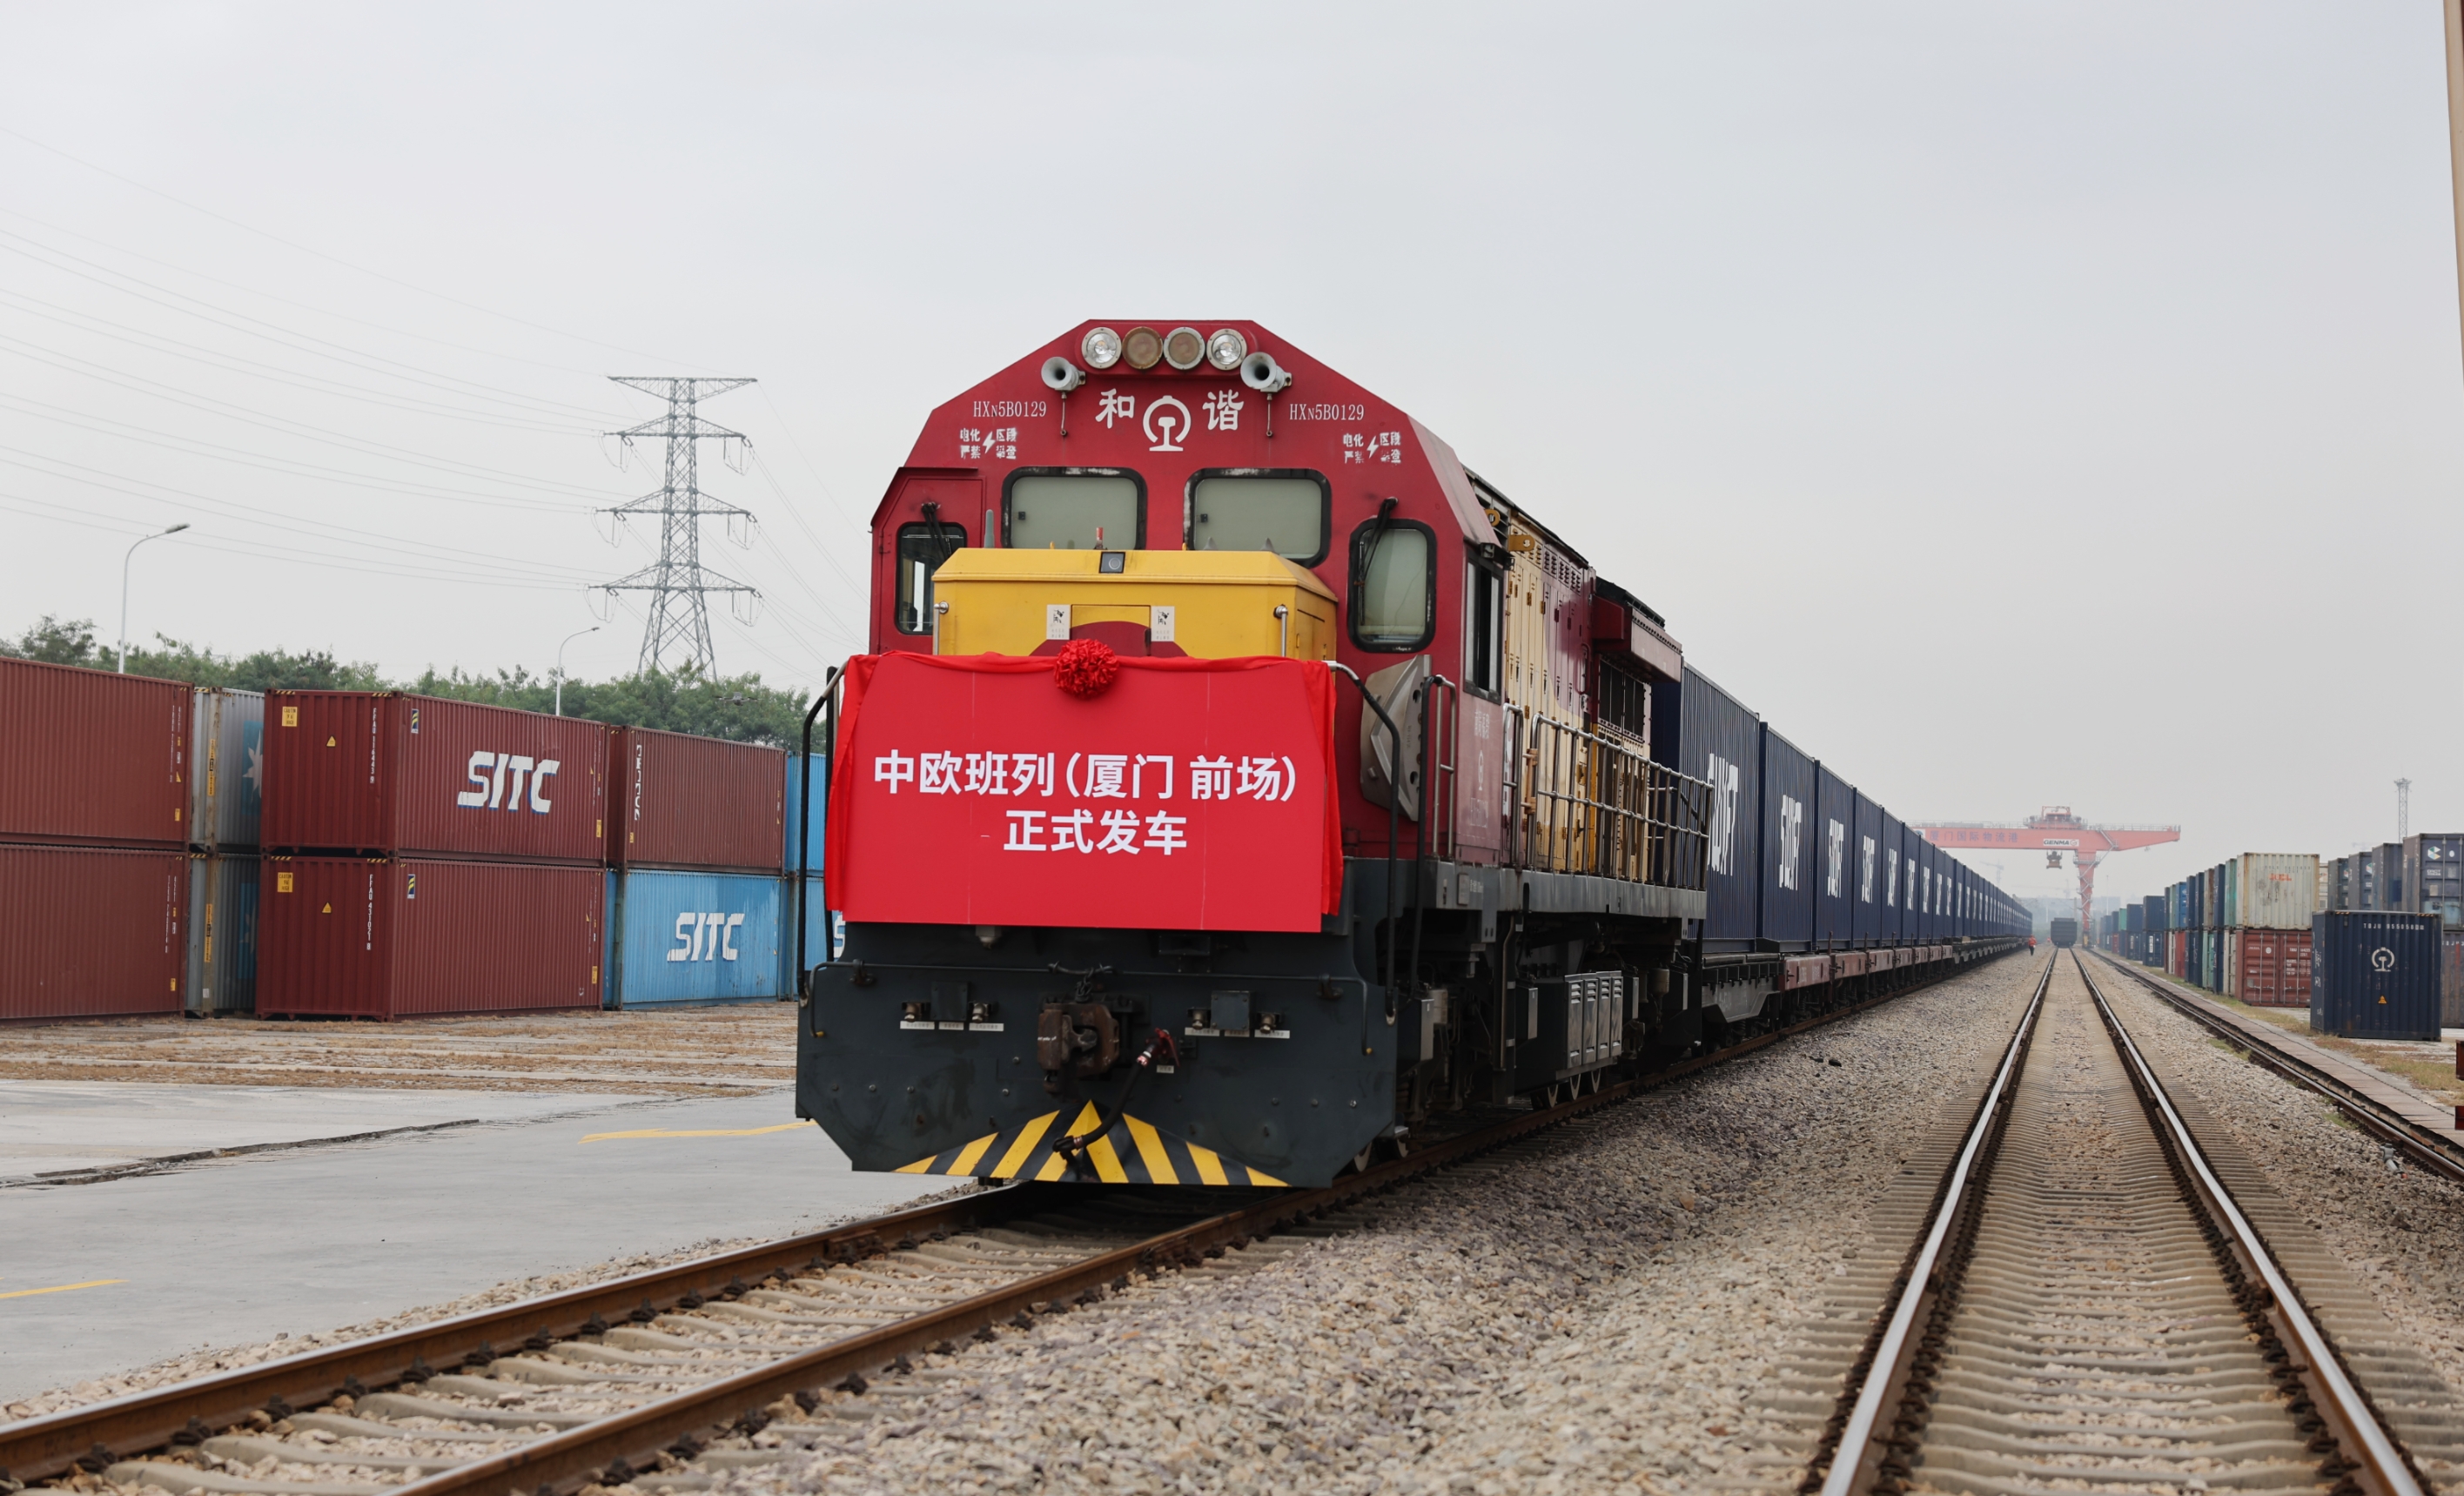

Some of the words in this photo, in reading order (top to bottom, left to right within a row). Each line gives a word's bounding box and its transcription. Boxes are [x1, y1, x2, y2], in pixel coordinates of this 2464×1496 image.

[1095, 388, 1135, 429] 和
[1202, 389, 1245, 431] 谐
[458, 750, 560, 815] SITC
[874, 749, 1173, 800] 中欧班列（厦门
[1189, 755, 1296, 802] 前场）
[1004, 808, 1187, 855] 正式发车
[1930, 830, 2018, 842] 厦门国际物流港
[667, 913, 745, 962] SITC
